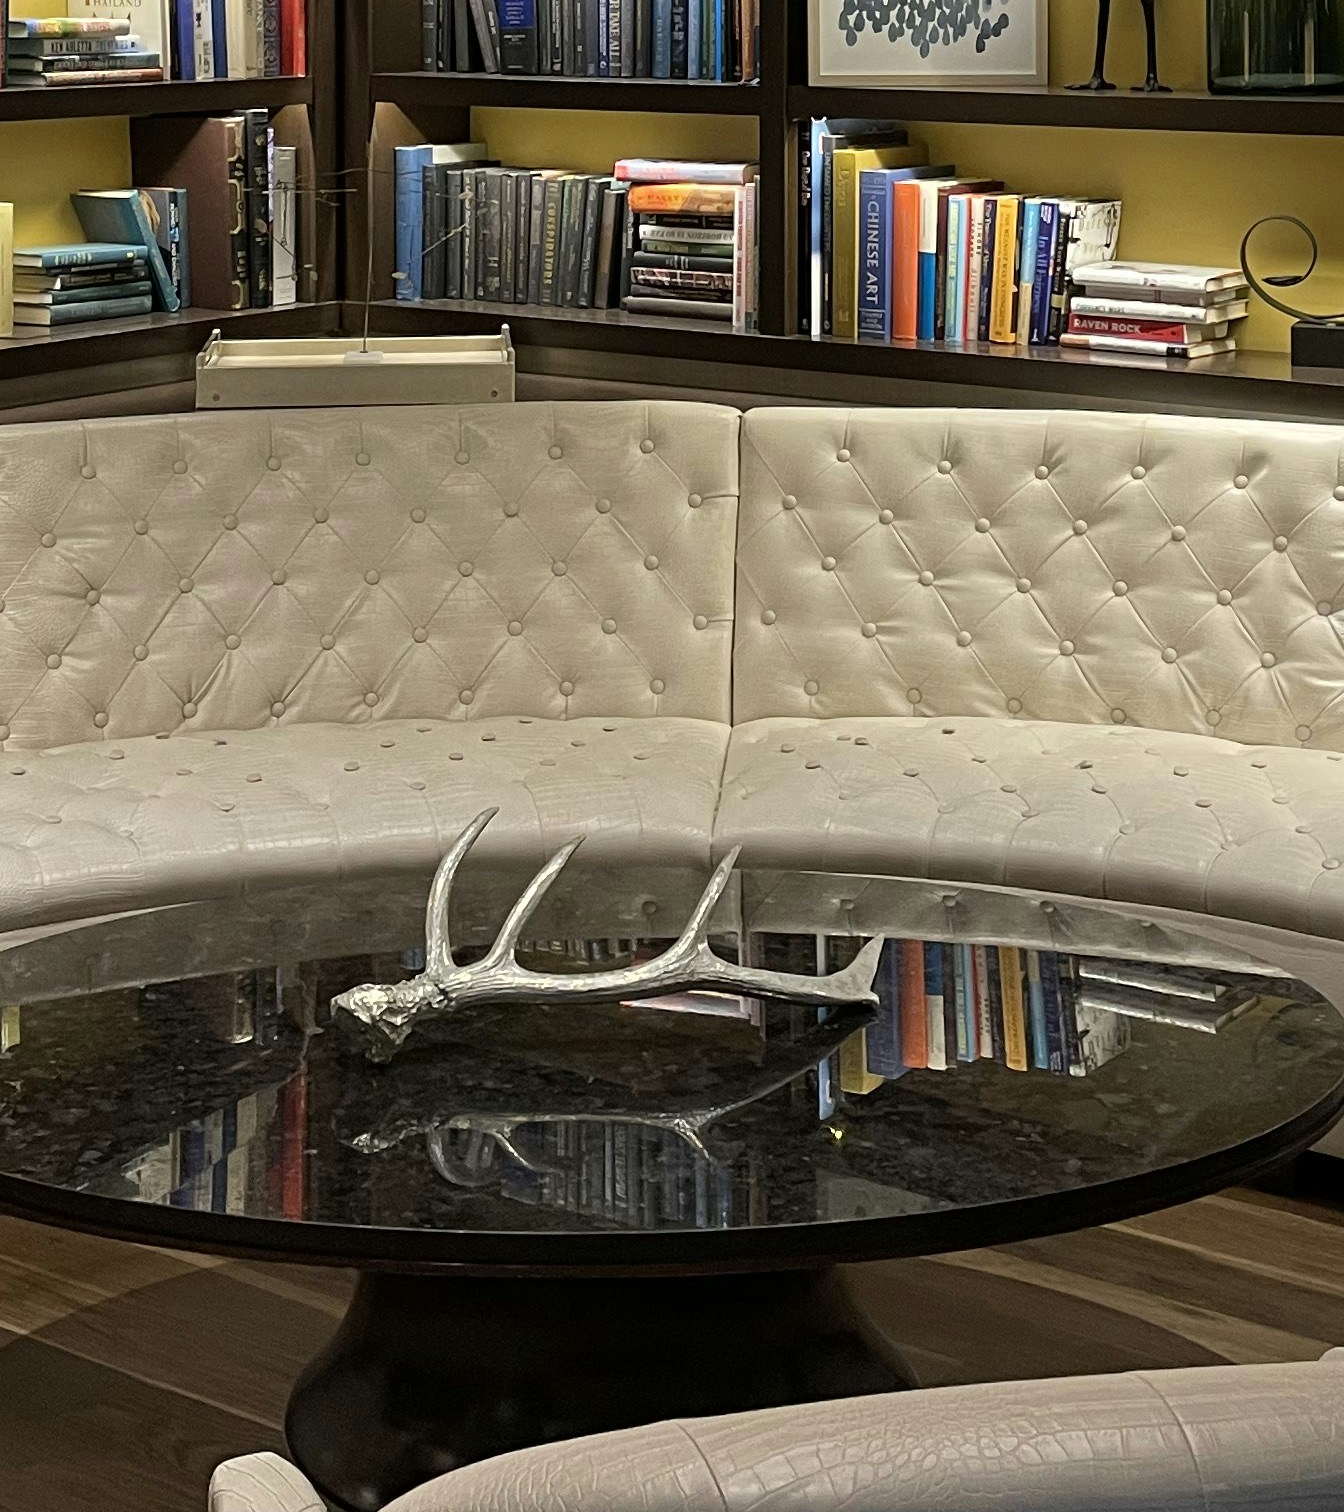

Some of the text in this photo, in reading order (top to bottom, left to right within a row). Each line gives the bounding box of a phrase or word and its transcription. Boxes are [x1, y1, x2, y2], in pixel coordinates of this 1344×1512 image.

[609, 10, 620, 36] TAKE
[64, 40, 92, 52] AULETTA
[609, 37, 620, 59] ALL
[543, 202, 557, 286] CONSPIRATORS
[866, 200, 881, 306] CHINESE ART
[1035, 235, 1049, 266] In All
[1073, 317, 1143, 335] RAVEN ROCK
